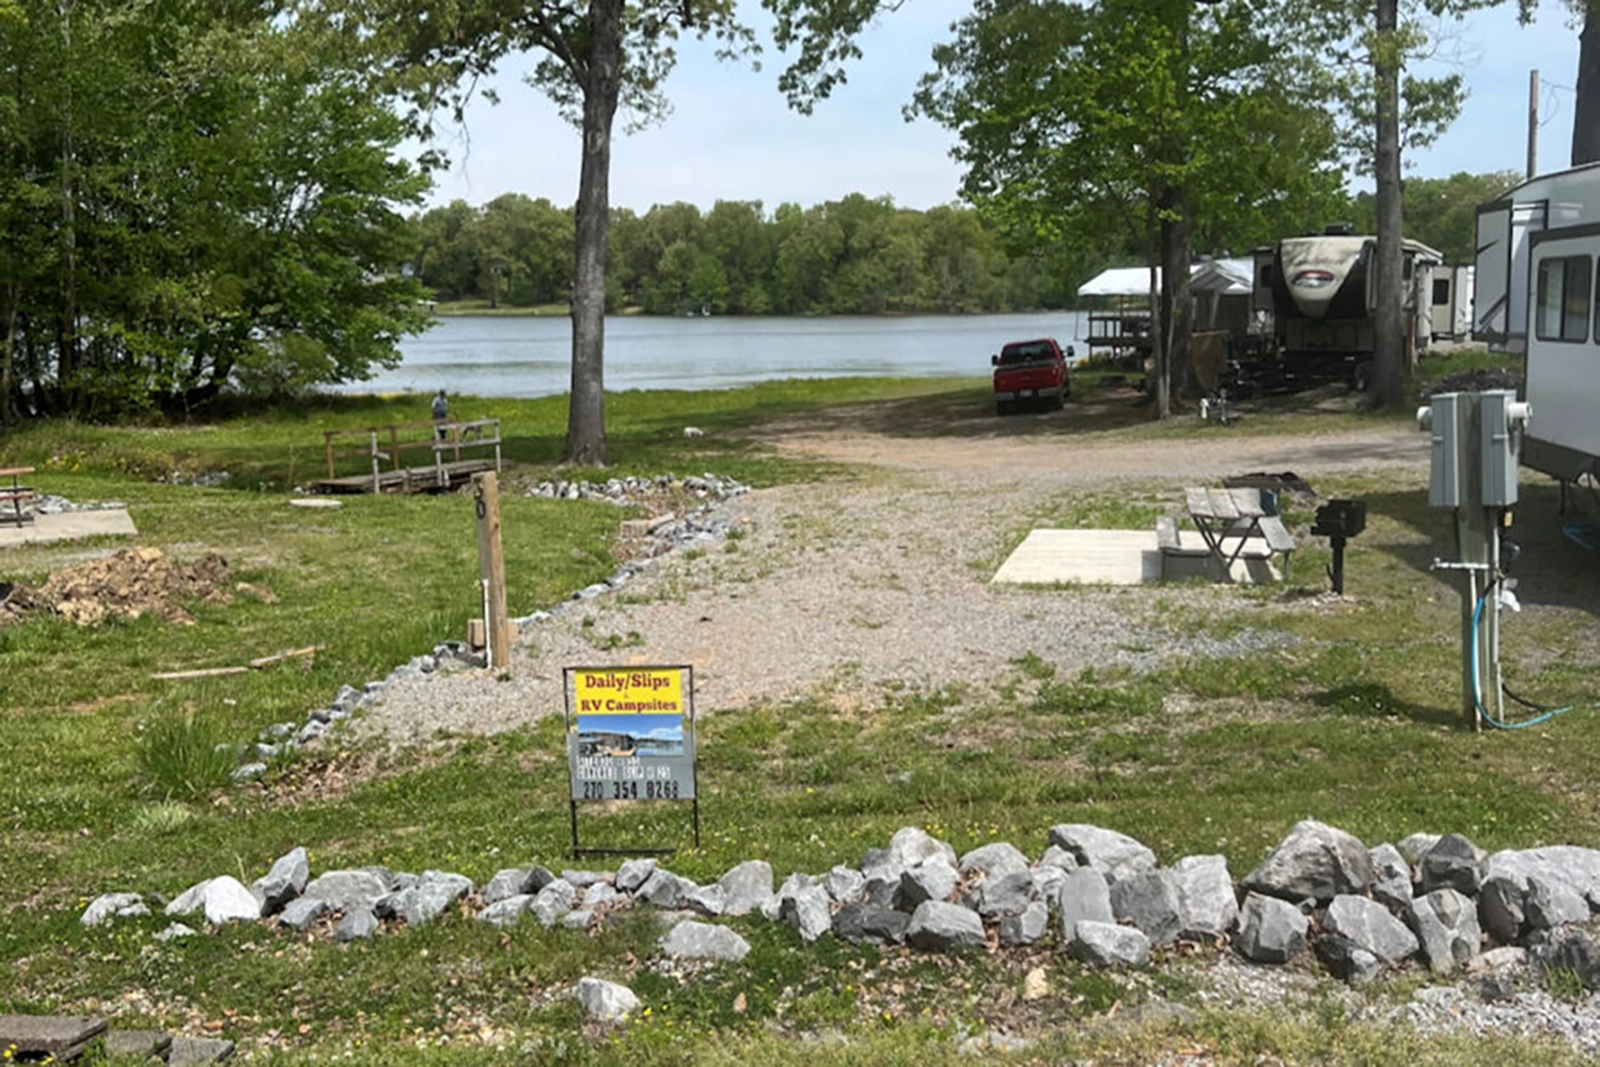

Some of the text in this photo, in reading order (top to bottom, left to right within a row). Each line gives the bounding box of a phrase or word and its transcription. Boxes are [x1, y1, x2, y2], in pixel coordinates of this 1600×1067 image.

[585, 673, 670, 691] Daily/Slips
[581, 699, 677, 714] RV Campsites
[583, 781, 604, 800] 270
[613, 781, 637, 800] 354
